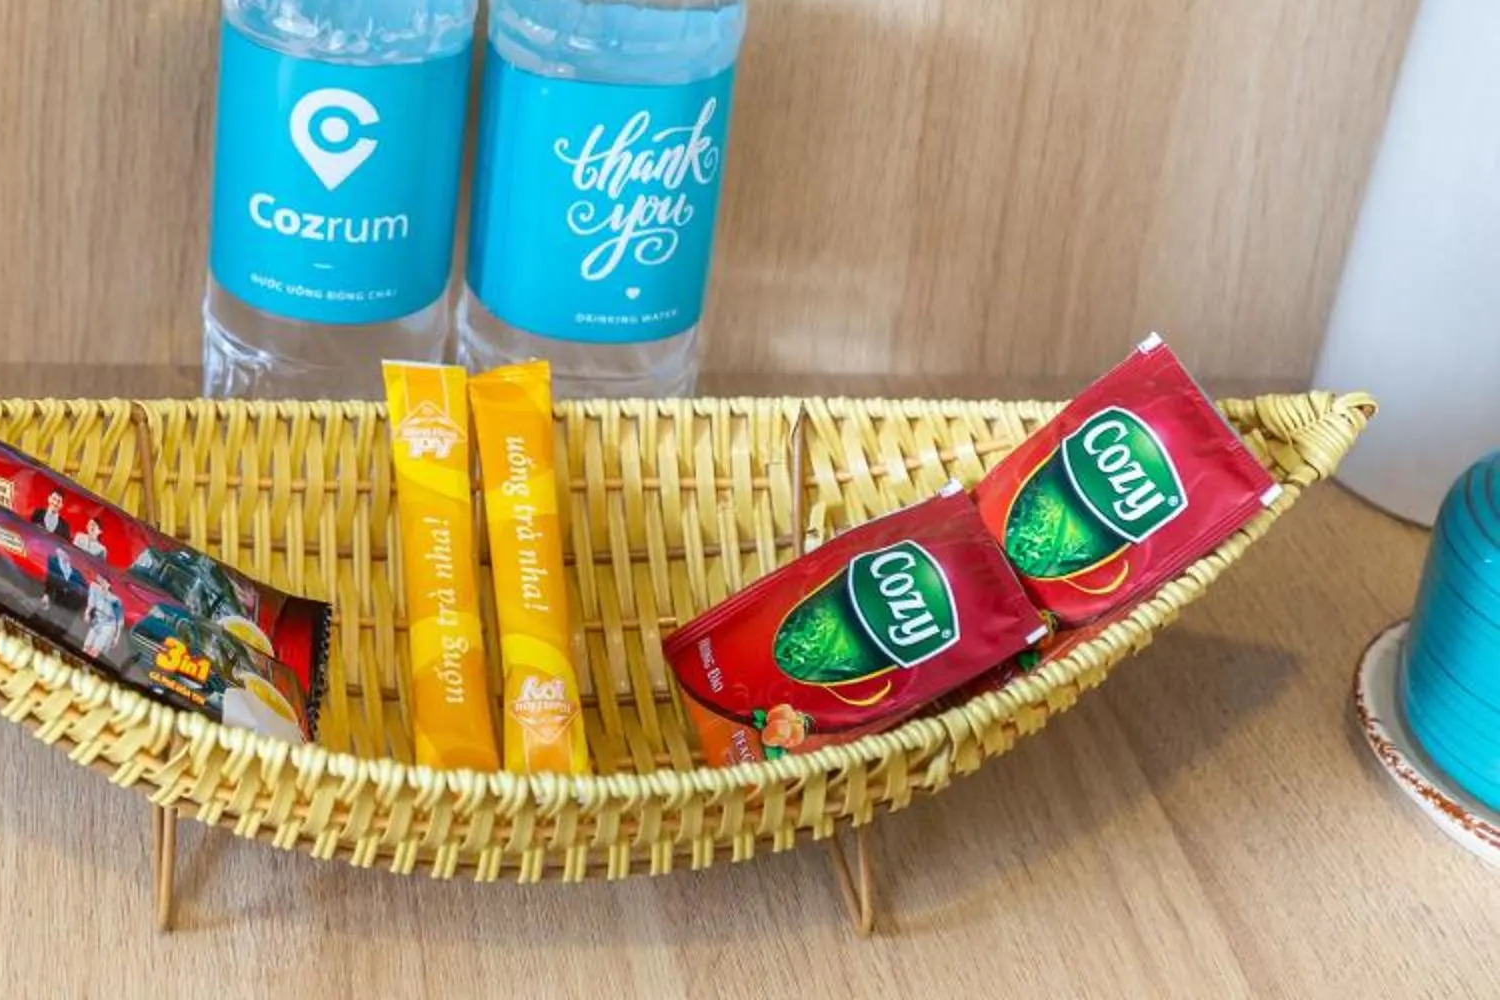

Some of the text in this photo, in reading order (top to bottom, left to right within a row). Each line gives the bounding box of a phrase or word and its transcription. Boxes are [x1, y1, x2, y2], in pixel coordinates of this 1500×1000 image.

[554, 96, 719, 199] thank
[249, 192, 409, 243] Cozrum
[567, 193, 694, 281] you
[575, 308, 678, 325] DRINKING WATER
[1083, 420, 1165, 521] Cozy
[513, 503, 544, 542] trà
[426, 587, 459, 627] trà
[870, 551, 941, 646] Cozy
[155, 636, 211, 684] 3in1
